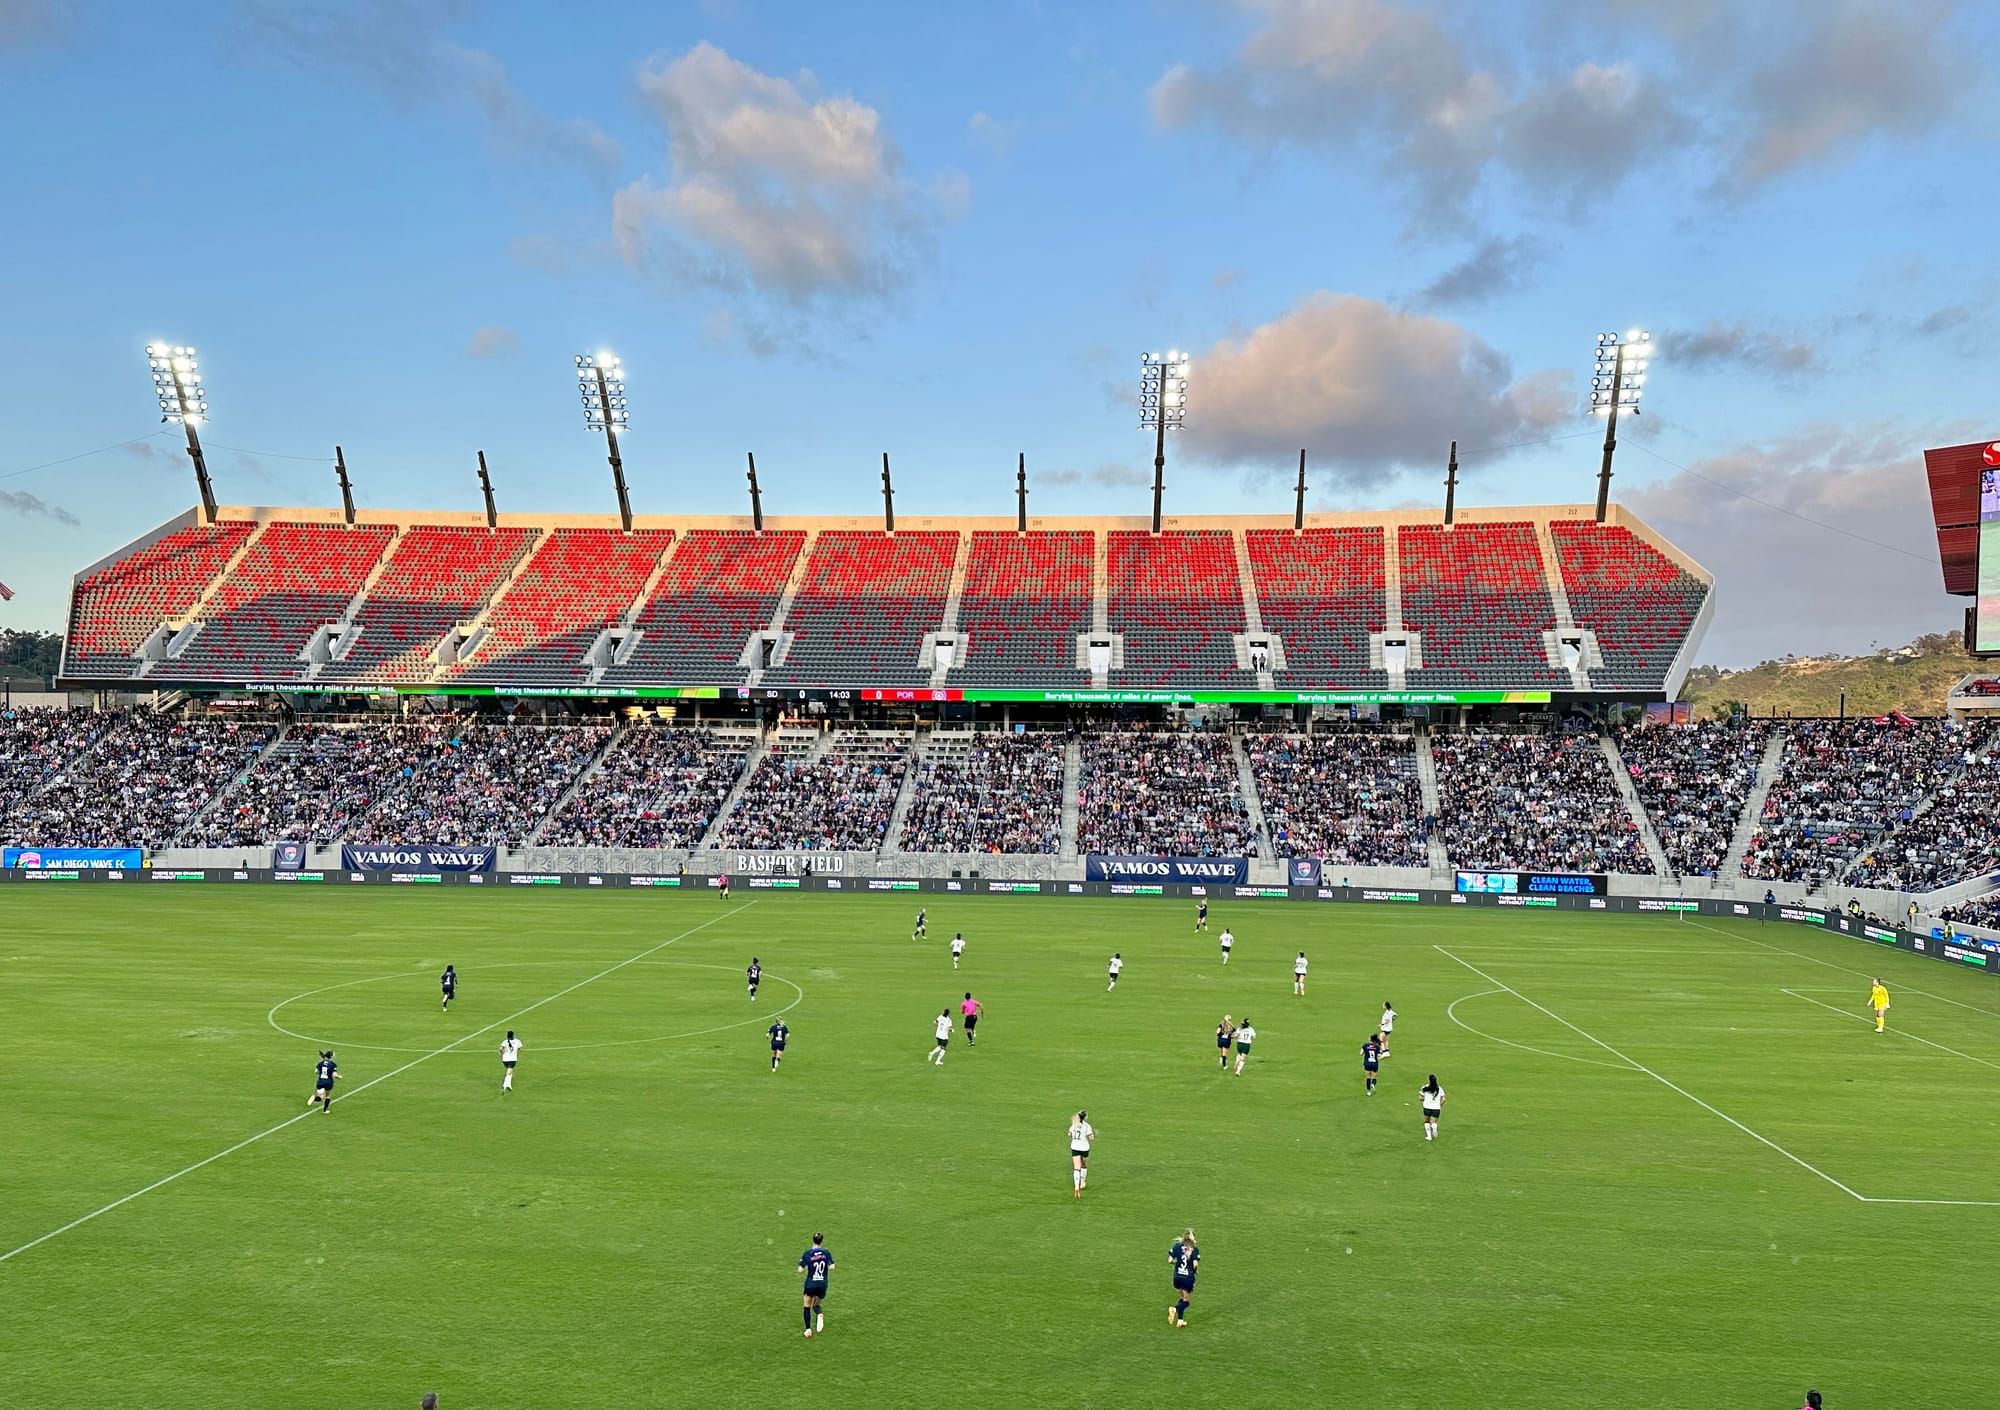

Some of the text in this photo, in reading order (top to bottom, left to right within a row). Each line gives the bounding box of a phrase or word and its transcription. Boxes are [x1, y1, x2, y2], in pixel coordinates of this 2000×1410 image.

[246, 683, 274, 692] Burying
[354, 685, 376, 693] power
[377, 684, 396, 692] lines.
[494, 687, 522, 695] Burying
[523, 687, 559, 695] thousands
[561, 687, 568, 695] of
[570, 687, 588, 695] miles
[598, 688, 619, 696] power
[620, 687, 638, 695] lines.
[767, 690, 914, 699] SD 0 14:03 0 POR
[1044, 692, 1073, 701] Burying
[1113, 692, 1120, 700] of
[1142, 693, 1149, 701] of
[1151, 694, 1173, 702] power
[1174, 693, 1193, 701] lines.
[1298, 694, 1326, 702] Burying
[1435, 694, 1456, 702] lines.
[354, 851, 485, 865] VAMOS WAVE
[46, 859, 125, 868] SAN DIEGO WAVE FC
[738, 855, 843, 872] BASHOR FIELD
[1099, 862, 1236, 876] VAMOS WAVE
[1531, 876, 1592, 886] CLEAN WATER,
[1529, 884, 1595, 893] CLEAN BEACHES
[813, 1261, 826, 1274] 20
